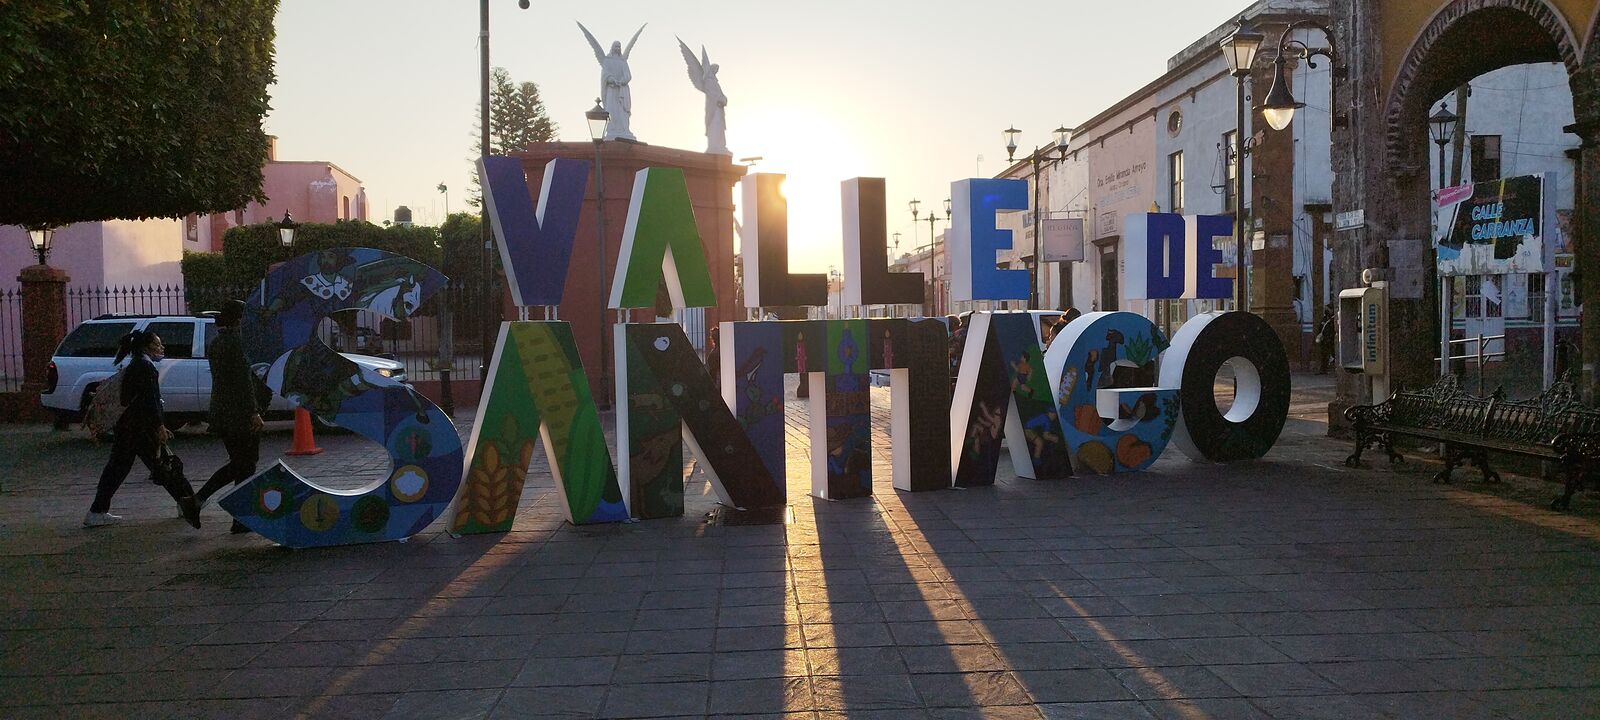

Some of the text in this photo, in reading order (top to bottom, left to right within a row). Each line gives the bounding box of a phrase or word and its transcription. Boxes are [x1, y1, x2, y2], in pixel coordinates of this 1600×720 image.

[477, 155, 1234, 309] VALLE DE
[1472, 202, 1504, 220] CALLE
[1472, 218, 1534, 240] CARRANZA
[1367, 303, 1377, 362] infinitum
[218, 247, 1292, 548] SANTIAGO
